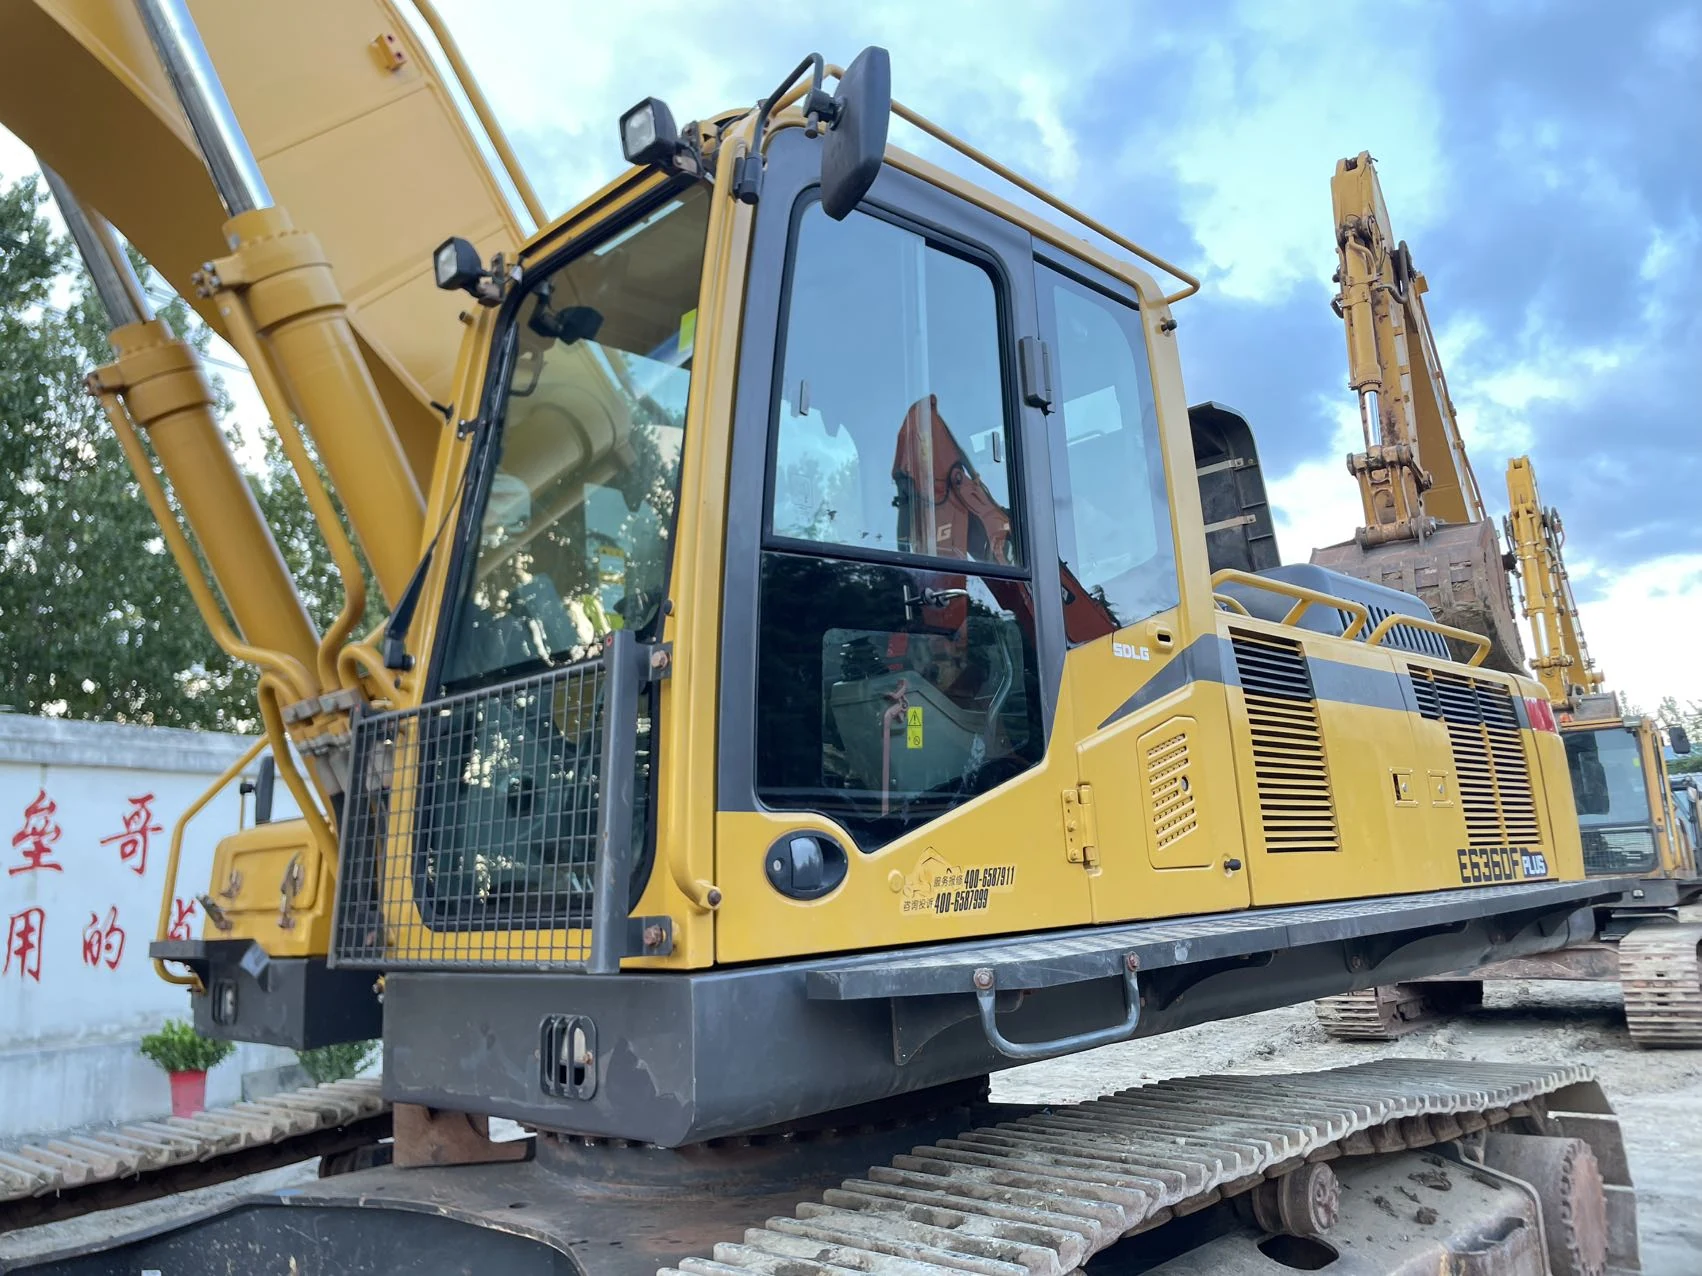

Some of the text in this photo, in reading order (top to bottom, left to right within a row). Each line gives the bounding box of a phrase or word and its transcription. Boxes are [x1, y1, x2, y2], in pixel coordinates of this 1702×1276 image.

[1113, 642, 1150, 661] SDLG
[1457, 847, 1547, 883] E6360F PLUS
[964, 866, 1015, 889] 400-6587911
[903, 888, 989, 914] 咨询投诉 400-6587999
